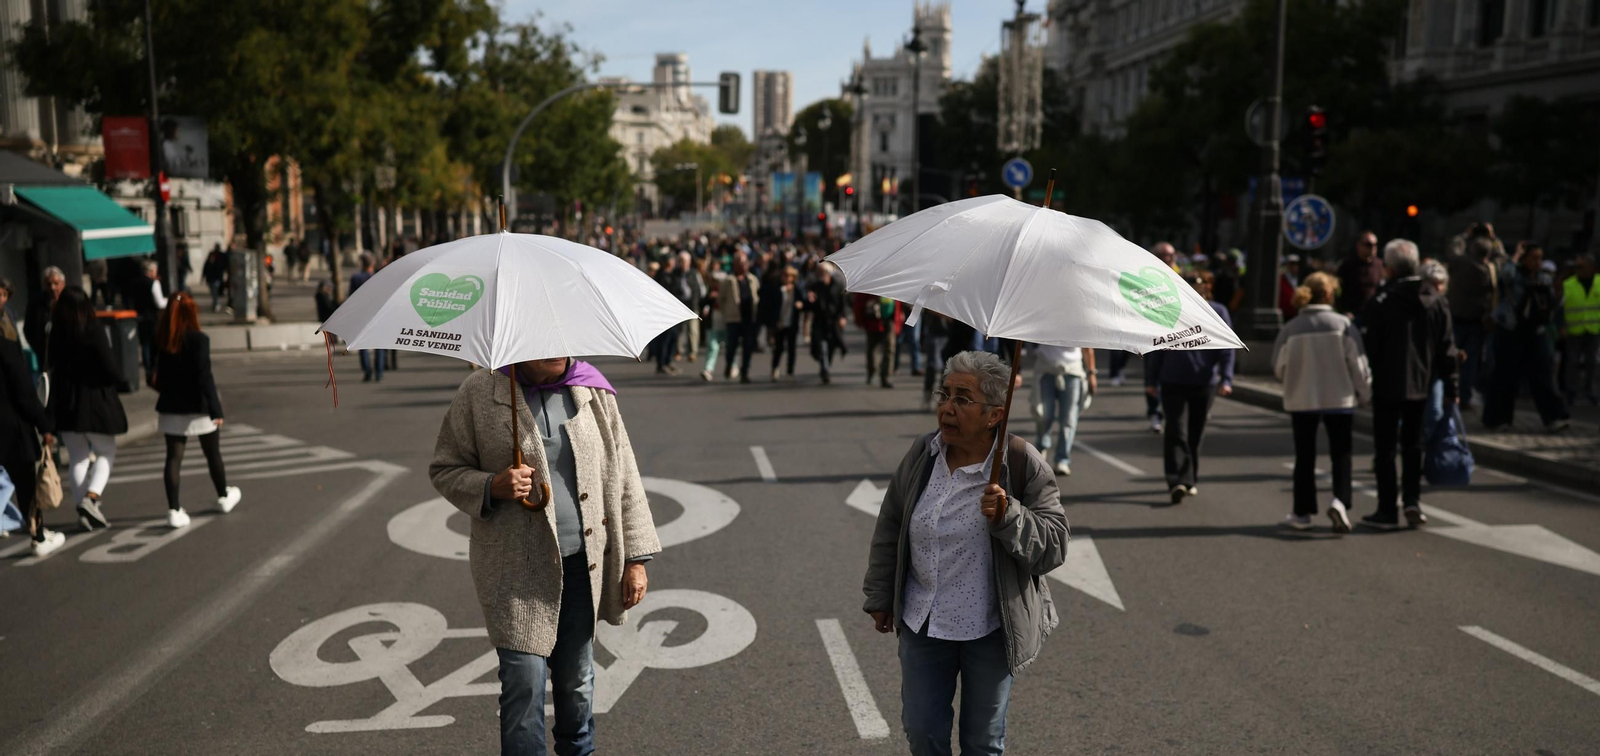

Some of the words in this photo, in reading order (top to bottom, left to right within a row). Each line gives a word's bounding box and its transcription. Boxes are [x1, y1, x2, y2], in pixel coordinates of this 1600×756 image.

[420, 288, 473, 300] Sanidad
[417, 298, 466, 310] Pública
[416, 330, 461, 341] SANIDAD
[1153, 337, 1166, 346] LA
[1167, 325, 1201, 342] SANIDAD
[1182, 335, 1211, 348] VENDE
[412, 339, 426, 347] SE
[428, 341, 461, 351] VENDE
